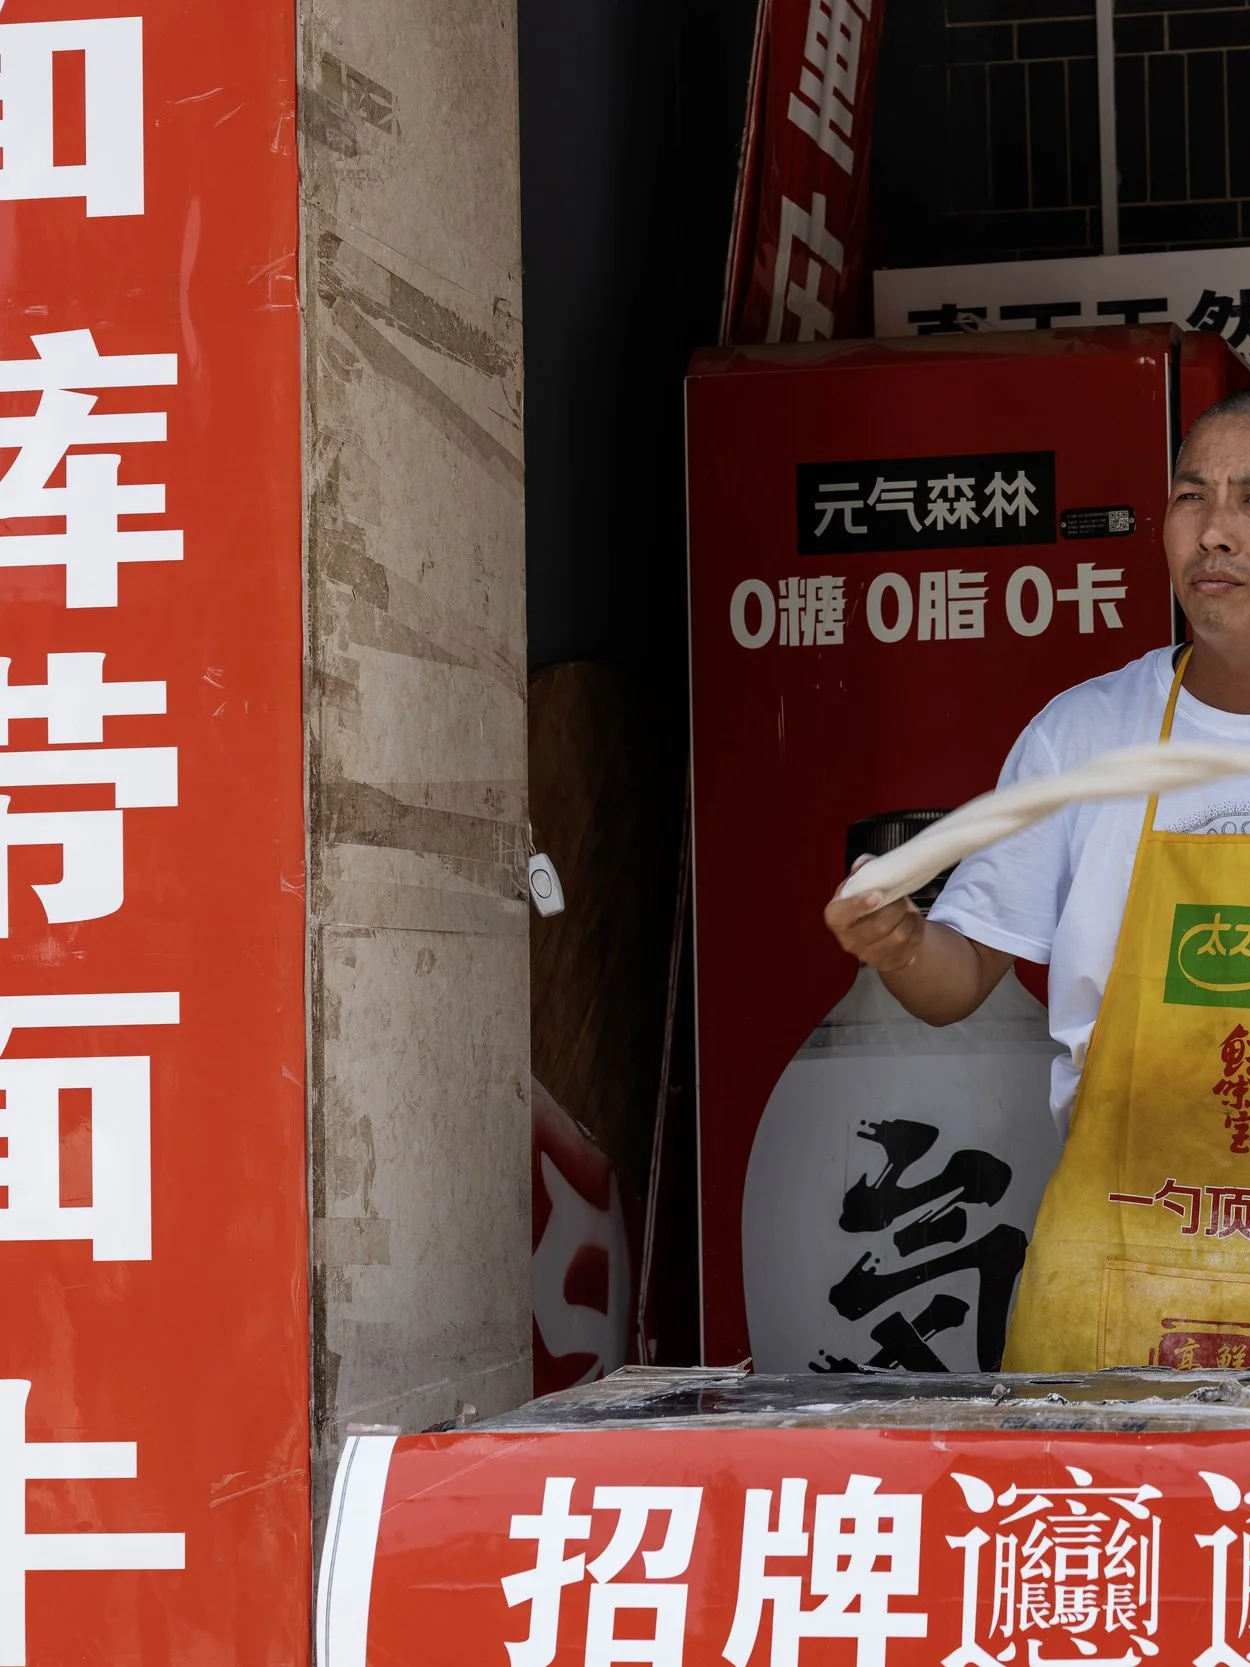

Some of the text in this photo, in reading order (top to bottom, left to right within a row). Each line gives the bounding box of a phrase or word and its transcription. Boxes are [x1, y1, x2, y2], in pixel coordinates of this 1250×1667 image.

[814, 470, 1040, 537] 元气森林
[730, 562, 1129, 650] 0糖 0脂 0卡
